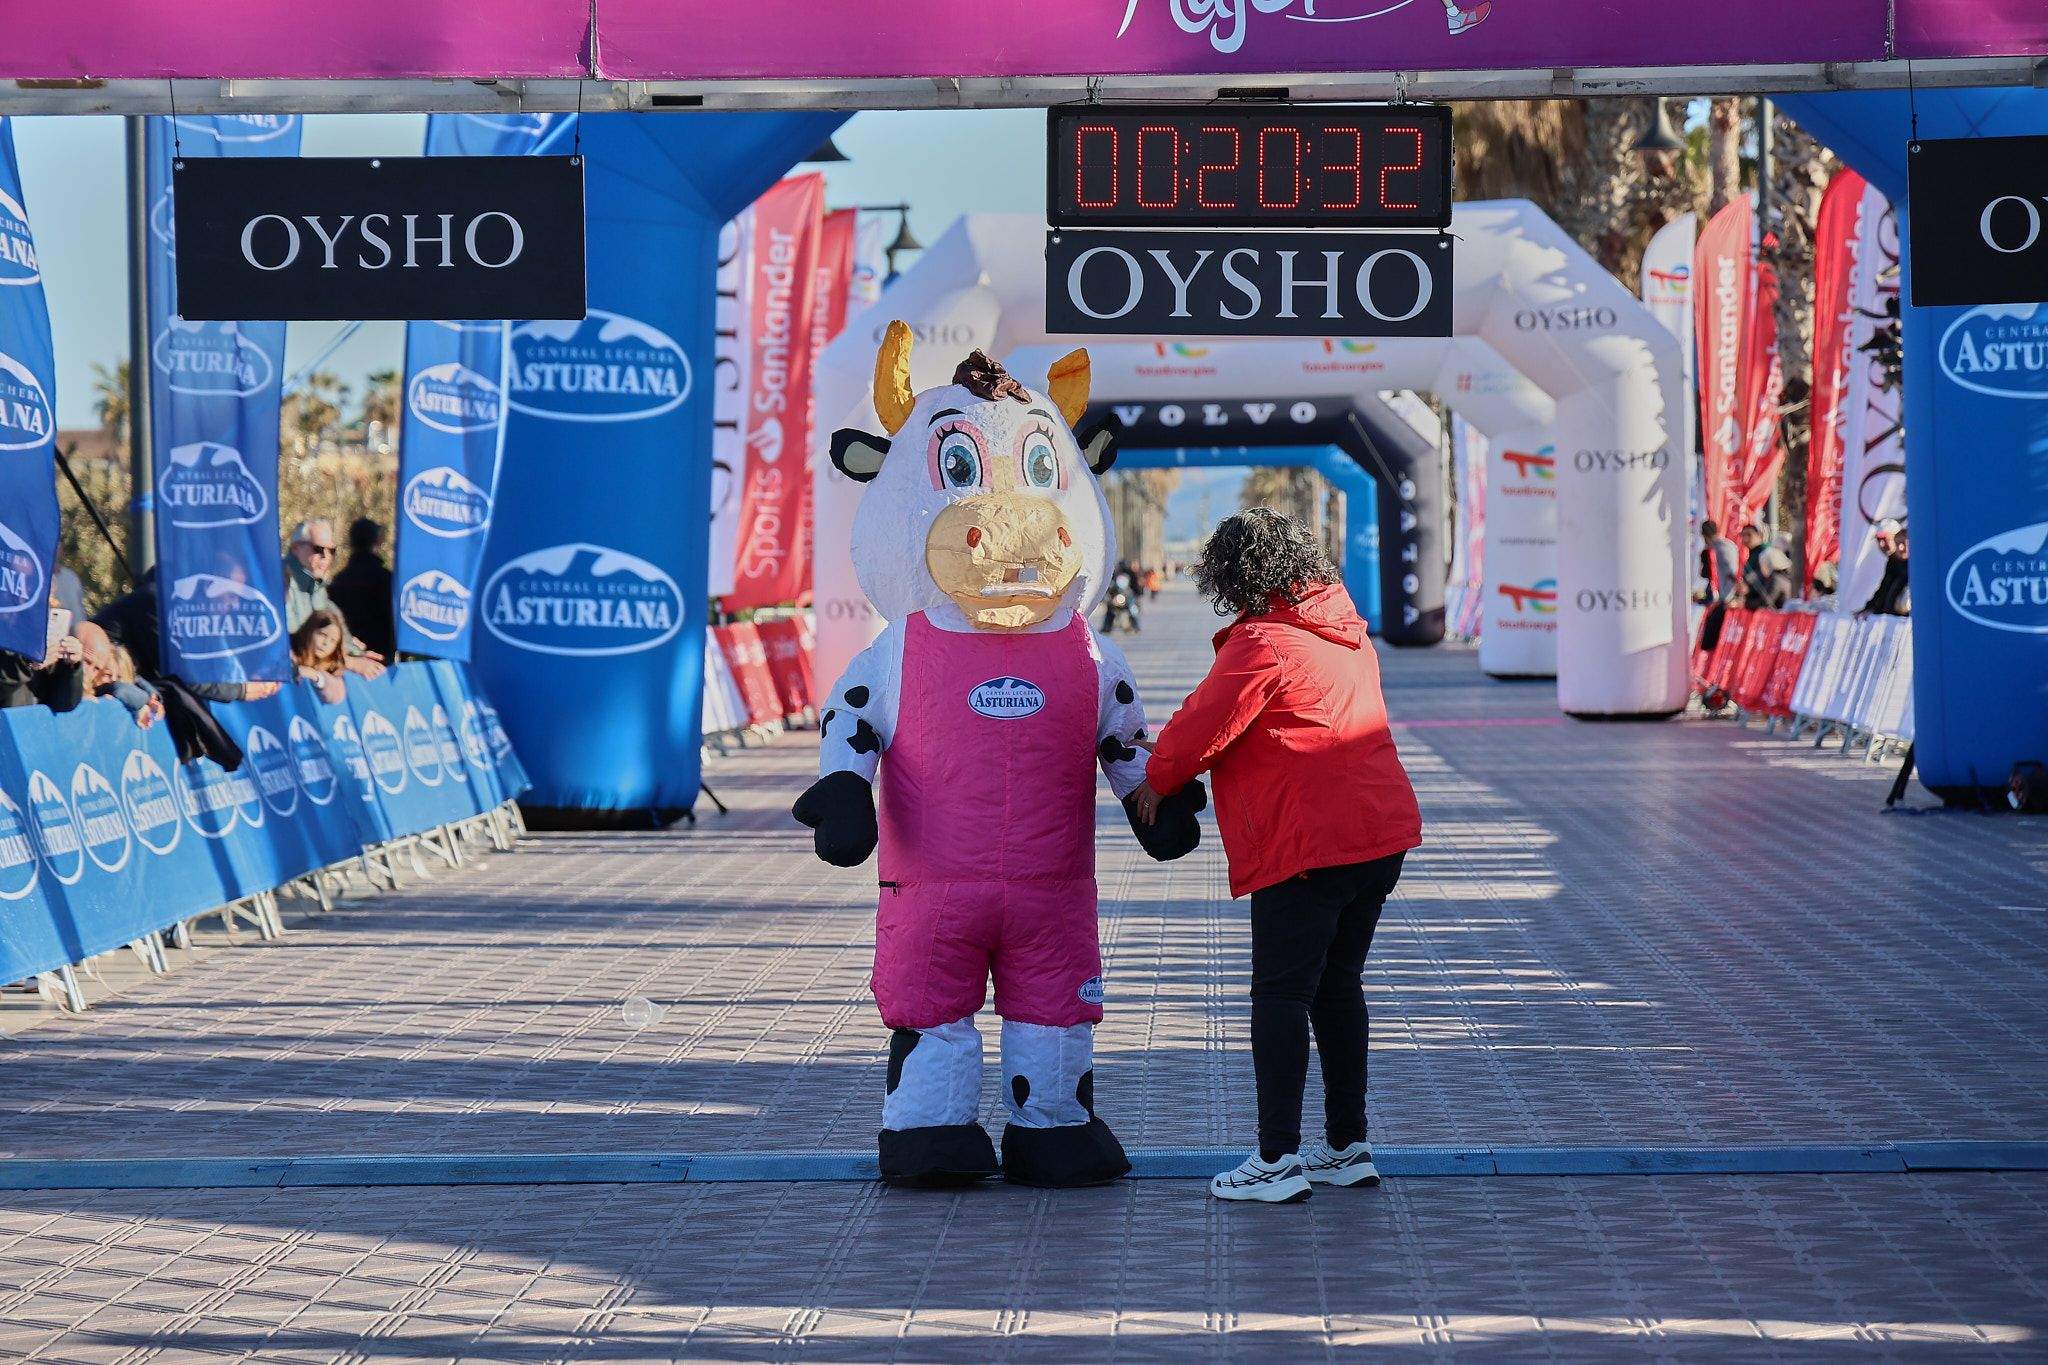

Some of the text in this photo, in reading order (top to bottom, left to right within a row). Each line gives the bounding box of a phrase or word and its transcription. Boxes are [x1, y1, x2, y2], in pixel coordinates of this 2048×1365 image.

[1076, 126, 1424, 208] 00:20:32
[240, 211, 524, 271] OYSHO
[1979, 195, 2048, 254] O
[1067, 246, 1433, 322] OYSHO
[753, 227, 796, 413] Santander
[1514, 305, 1618, 333] OYSHO
[1715, 254, 1738, 413] Santander
[526, 346, 598, 360] CENTRAL
[1112, 401, 1317, 427] VOLVO
[1574, 449, 1670, 475] OYSHO
[743, 467, 786, 579] Sports
[492, 582, 672, 629] ASTURIANA
[519, 579, 667, 596] CENTRAL LECHERA
[1961, 563, 2048, 606] ASTU
[974, 692, 1040, 708] ASTURIANA
